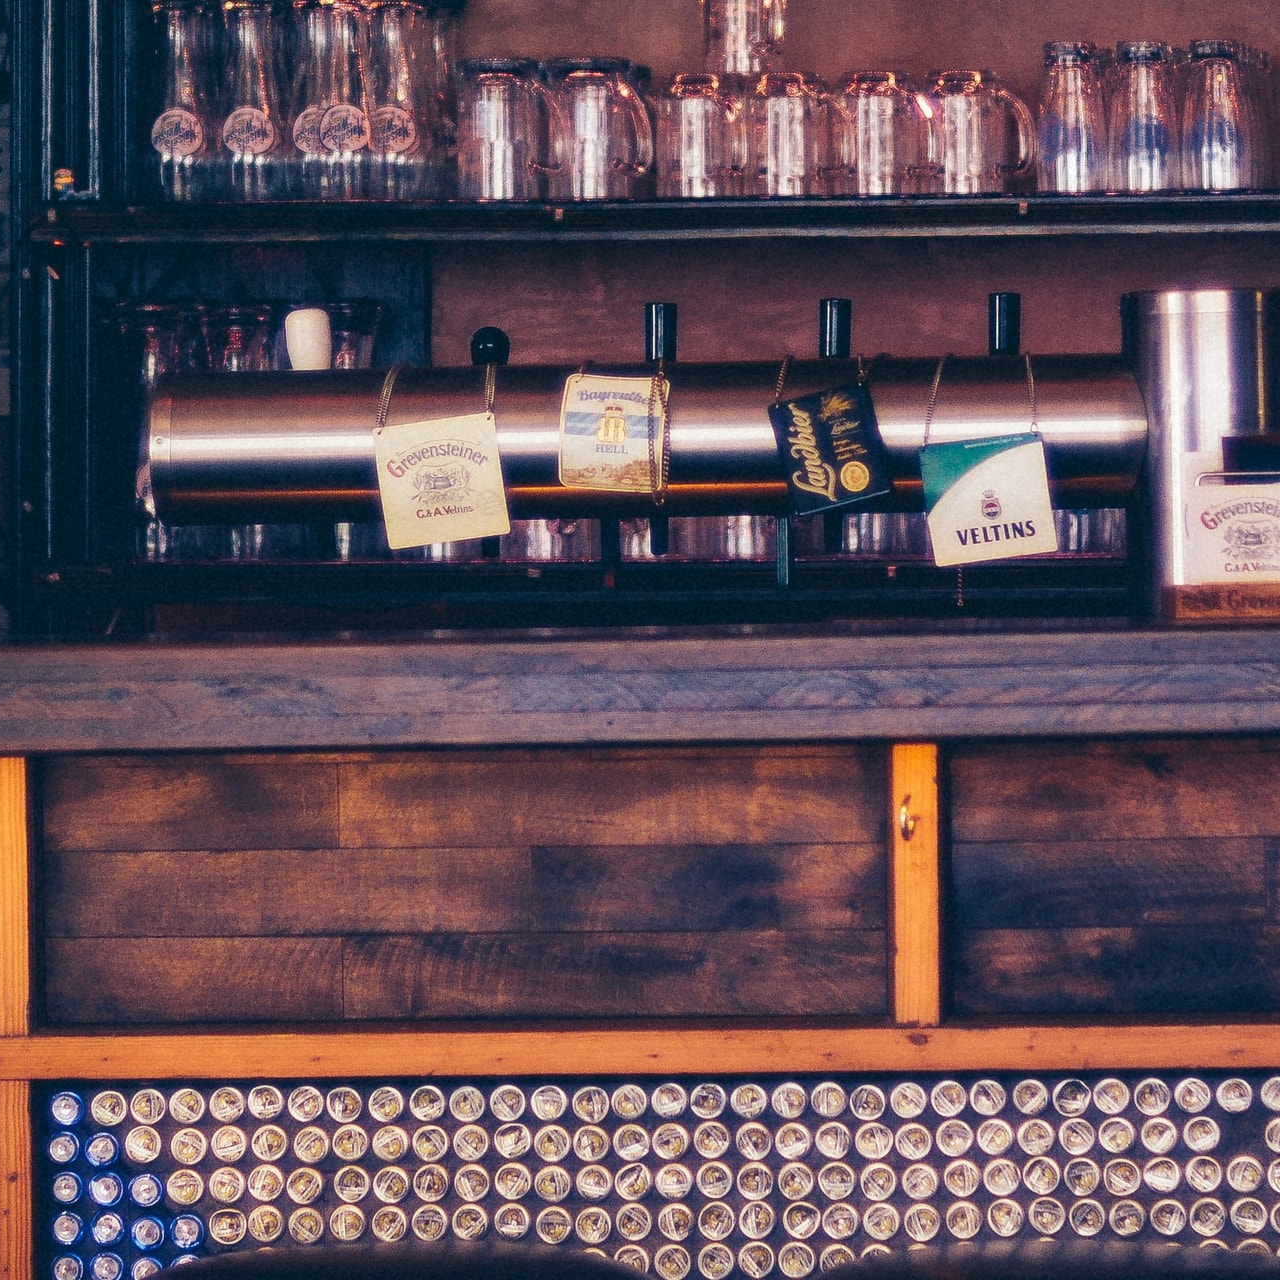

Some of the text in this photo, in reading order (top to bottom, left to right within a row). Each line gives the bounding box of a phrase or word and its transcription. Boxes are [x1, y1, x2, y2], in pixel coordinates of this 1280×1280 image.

[577, 389, 650, 406] Bayreuthe
[386, 441, 488, 480] Grevensteiner
[595, 443, 629, 455] HELL
[788, 403, 837, 502] Landbier
[956, 520, 1036, 546] VELTINS
